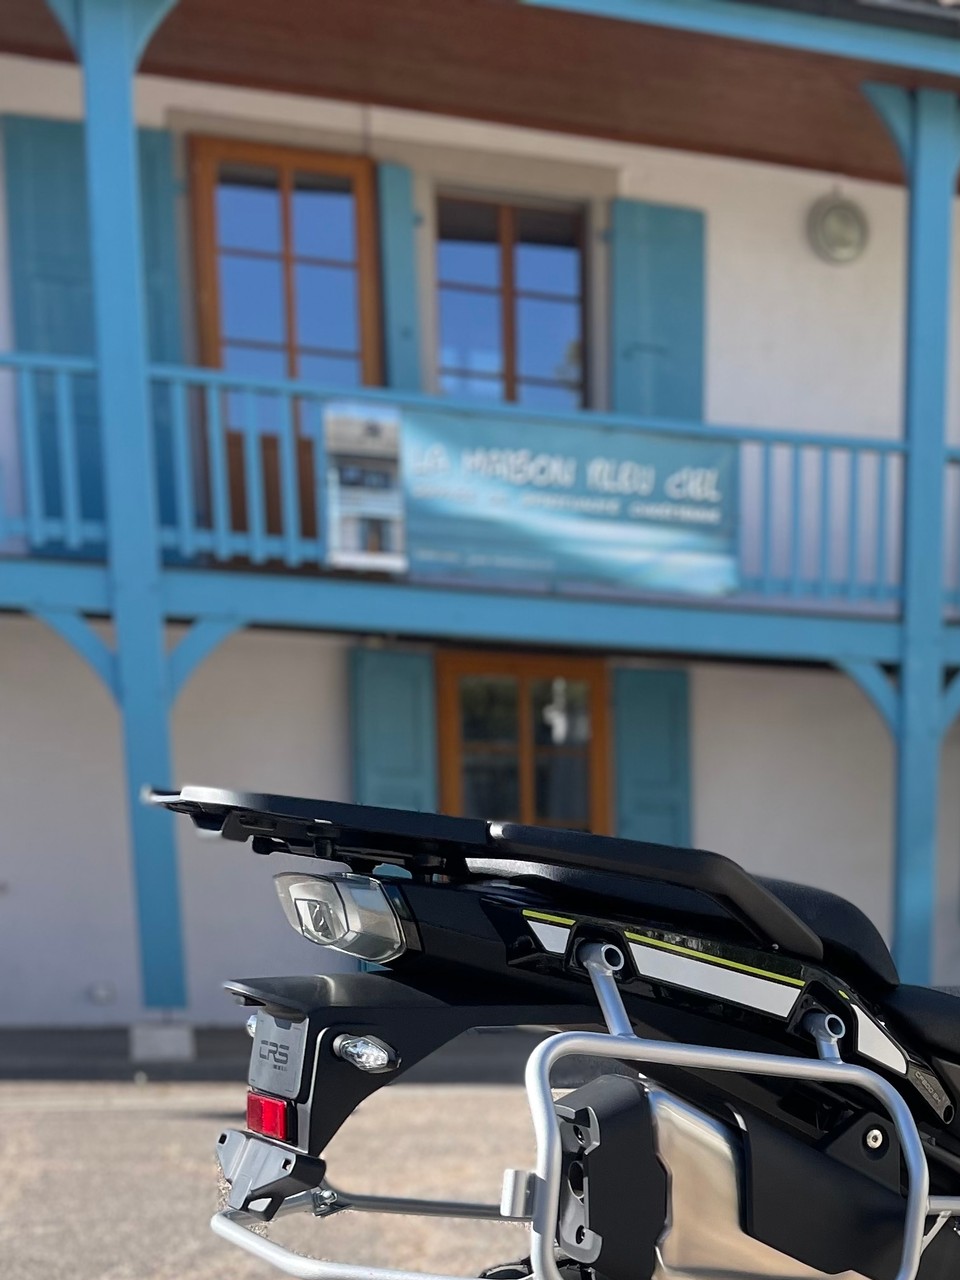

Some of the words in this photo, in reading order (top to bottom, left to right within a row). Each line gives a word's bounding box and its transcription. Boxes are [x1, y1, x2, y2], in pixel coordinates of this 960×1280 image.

[411, 443, 450, 478] LA
[461, 446, 575, 487] MAISON
[259, 1039, 290, 1065] CRS
